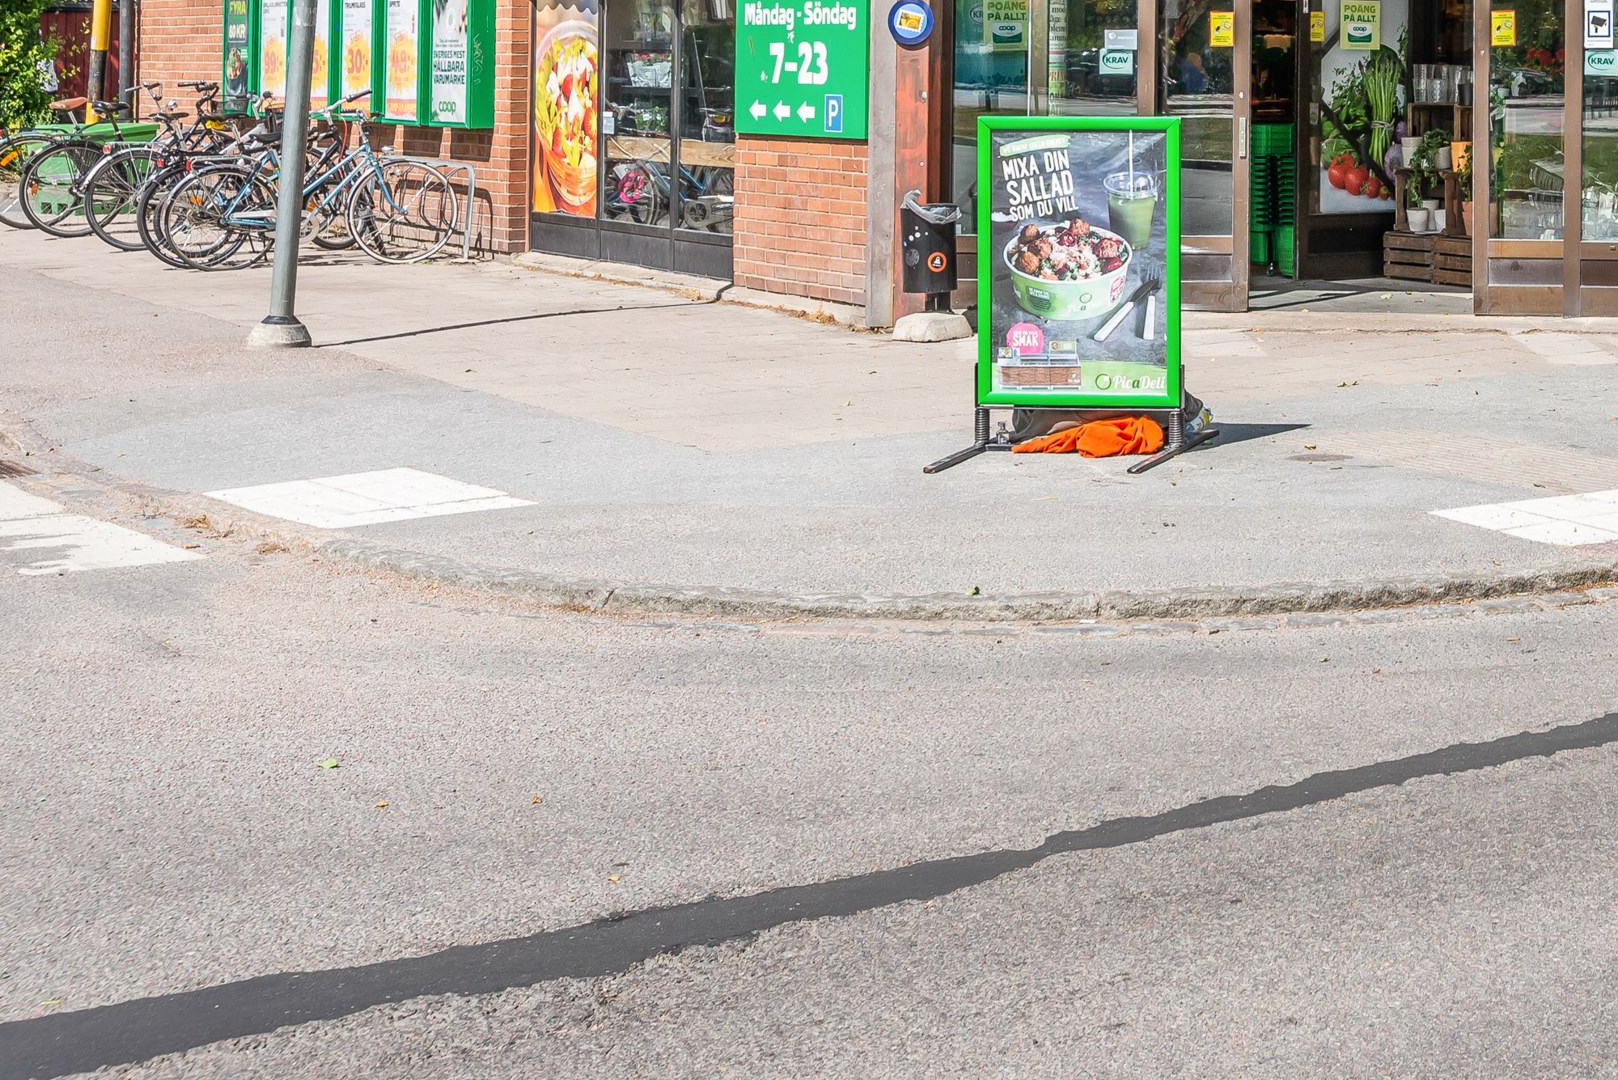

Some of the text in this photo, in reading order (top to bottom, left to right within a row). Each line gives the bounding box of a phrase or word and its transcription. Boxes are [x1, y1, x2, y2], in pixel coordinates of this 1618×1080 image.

[229, 0, 246, 16] FYRA
[744, 1, 794, 30] Måndag
[803, 1, 857, 30] Söndag
[987, 11, 1028, 21] PÅ ALLT.
[1343, 14, 1377, 23] PÅ ALLT.
[236, 24, 246, 39] KR
[769, 41, 829, 85] 7-23
[1105, 56, 1129, 64] KRAV
[1591, 57, 1615, 65] KRAV
[438, 100, 457, 115] coop
[828, 99, 839, 127] P
[1002, 149, 1070, 181] MIXA DIN
[1006, 170, 1074, 206] SALLAD
[1009, 195, 1079, 222] SOM DU VILL
[1012, 334, 1039, 347] SMAK
